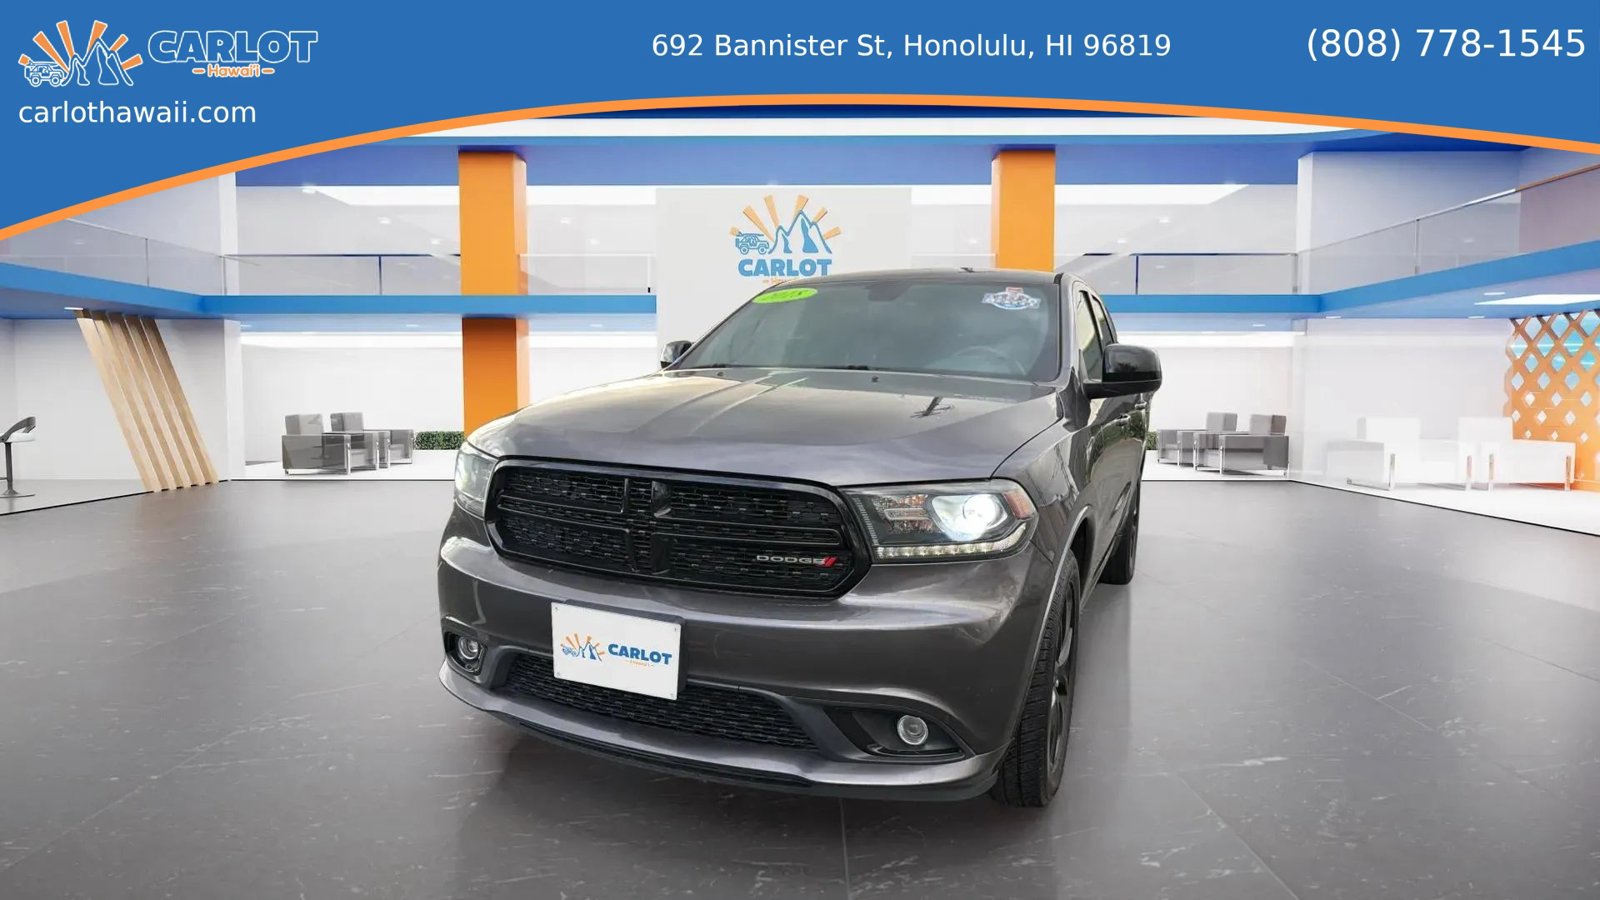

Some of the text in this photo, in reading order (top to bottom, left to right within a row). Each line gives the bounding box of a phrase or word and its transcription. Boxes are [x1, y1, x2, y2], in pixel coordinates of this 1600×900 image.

[738, 258, 832, 277] CARLOT
[756, 555, 825, 565] DODGE
[607, 643, 673, 665] CARLOT
